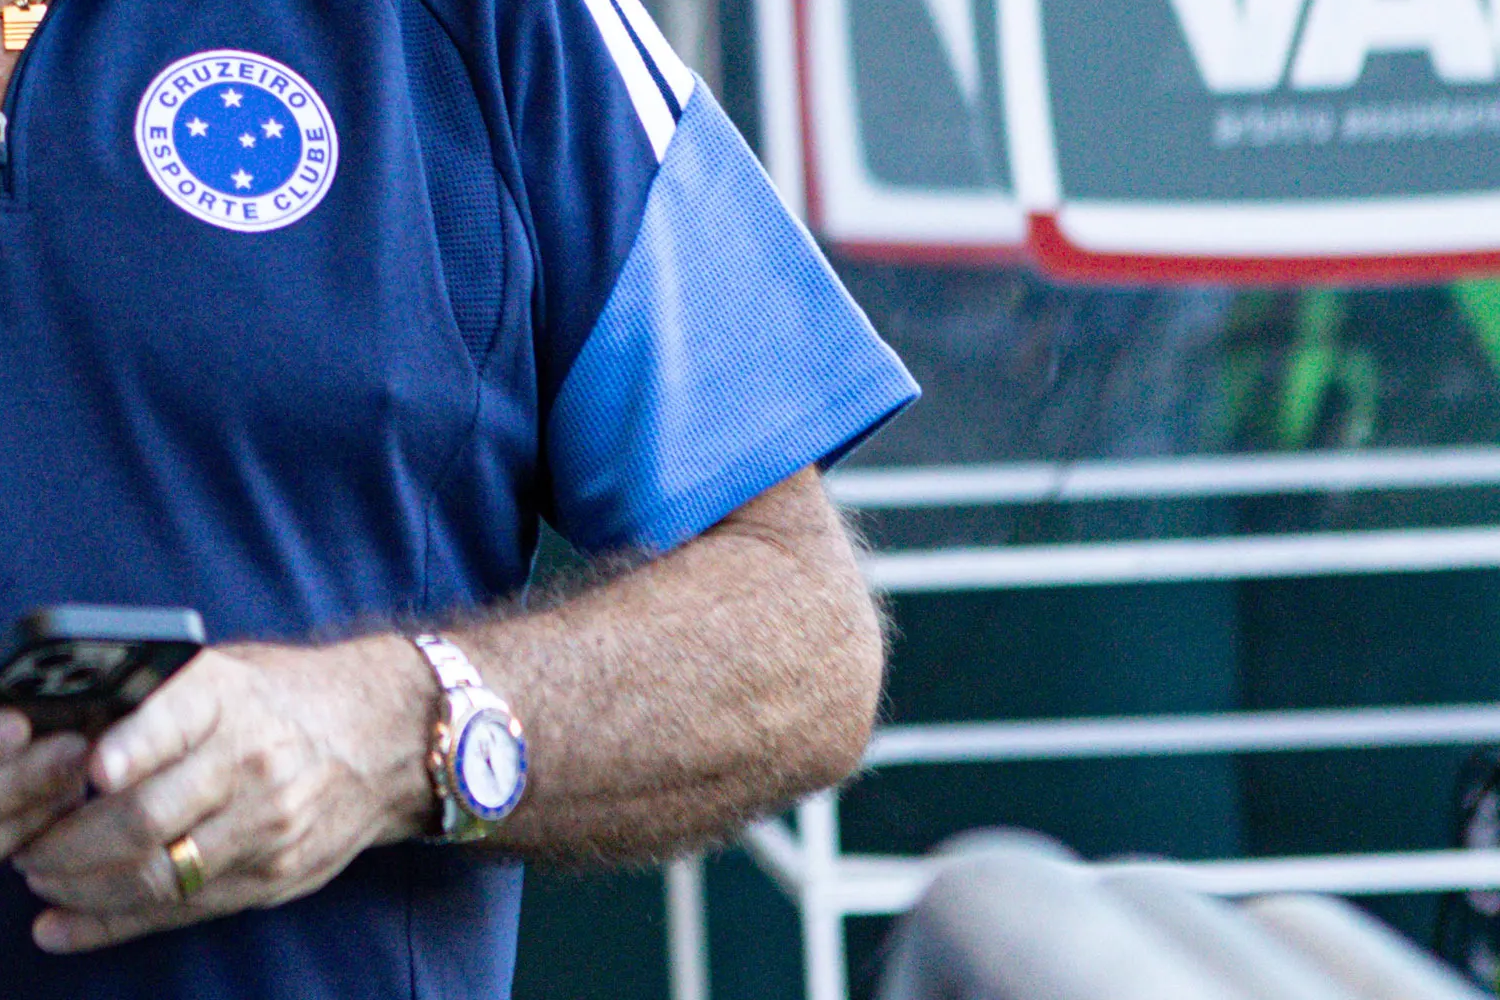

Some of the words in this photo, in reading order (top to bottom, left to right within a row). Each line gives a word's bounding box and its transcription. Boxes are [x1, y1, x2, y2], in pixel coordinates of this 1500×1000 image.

[159, 62, 307, 108] CRUZEIRO
[150, 126, 259, 220] ESPORTE
[273, 127, 325, 210] CLUBE
